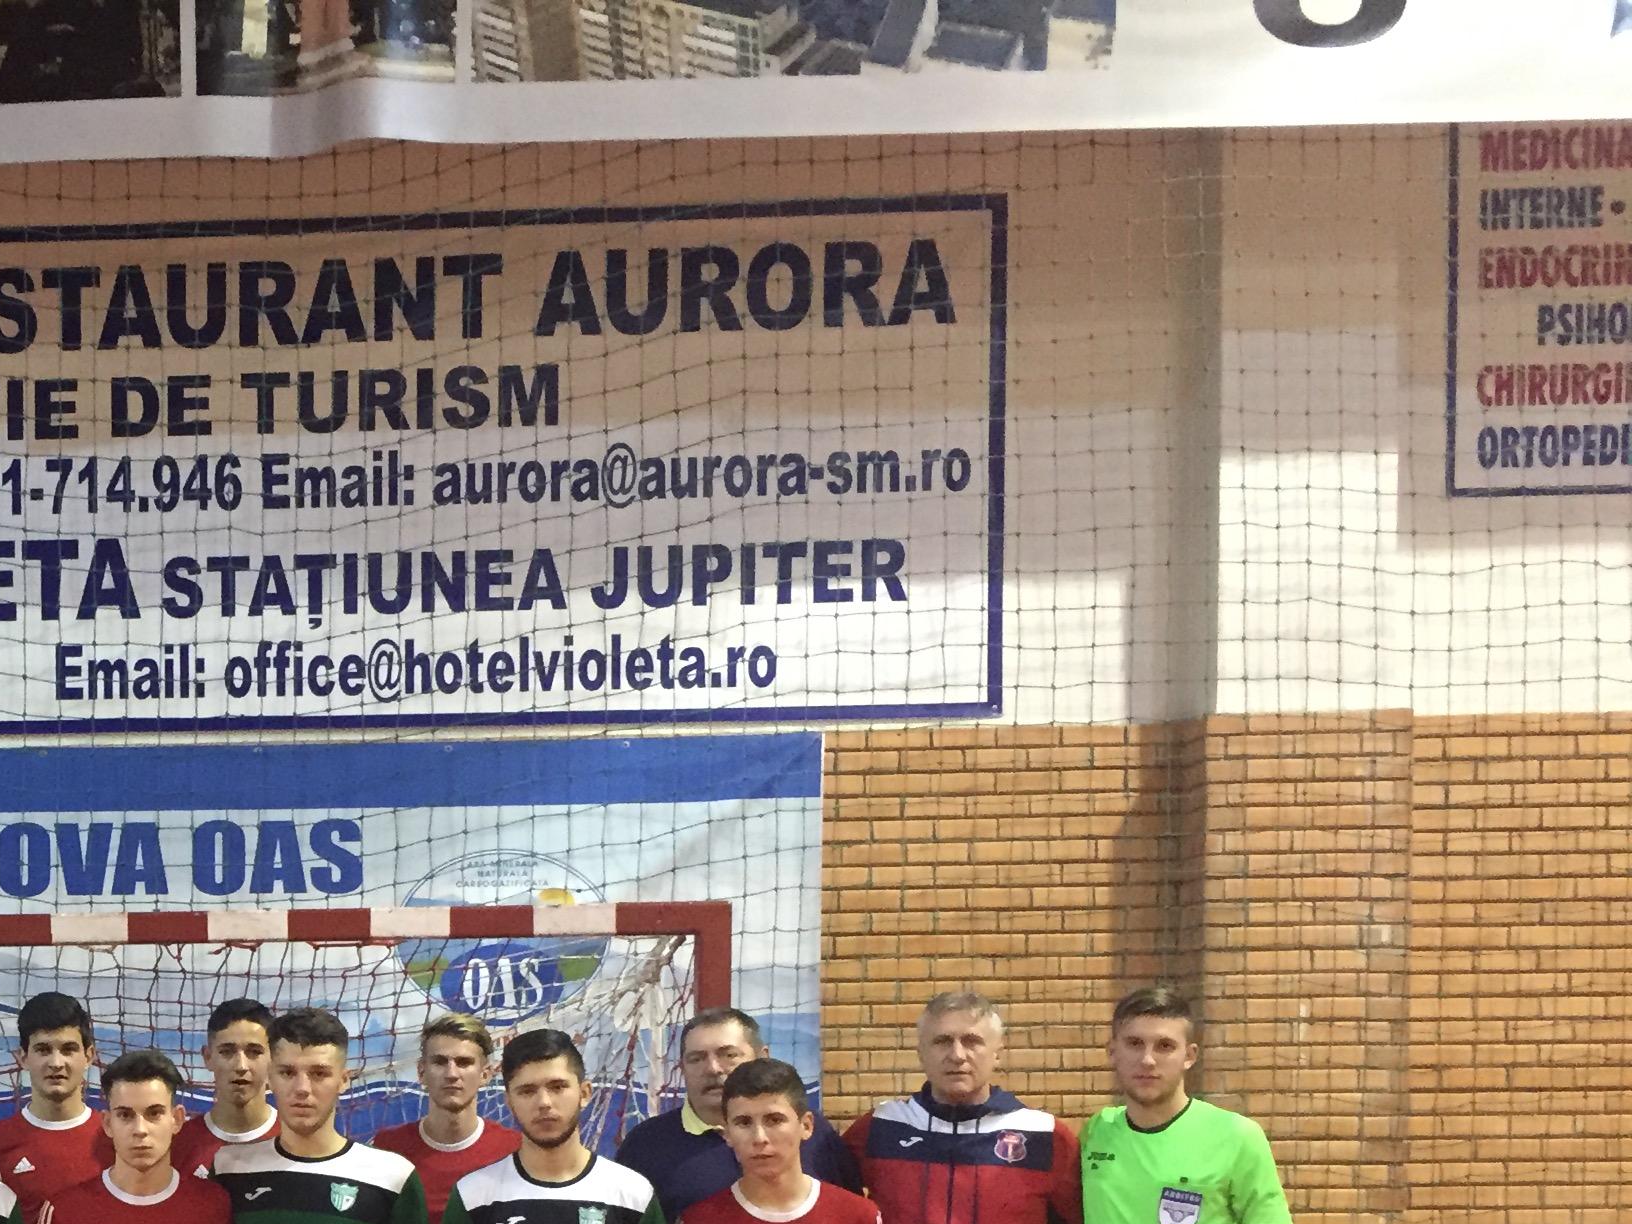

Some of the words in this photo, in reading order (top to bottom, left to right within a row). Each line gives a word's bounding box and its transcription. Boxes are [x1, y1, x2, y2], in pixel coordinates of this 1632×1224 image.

[1479, 185, 1605, 231] INTERNE
[534, 238, 956, 338] AURORA
[1537, 303, 1632, 346] PSIHO
[110, 374, 213, 439] DE
[240, 363, 559, 436] TURISM
[261, 450, 414, 510] Email:
[433, 442, 971, 508] aurora@aurora-sm.ro
[162, 548, 567, 630] STAȚIUNEA
[591, 537, 907, 611] JUPITER
[55, 643, 206, 701] Email:
[223, 635, 777, 703] office@hotelvioleta.ro
[192, 818, 365, 896] OAS
